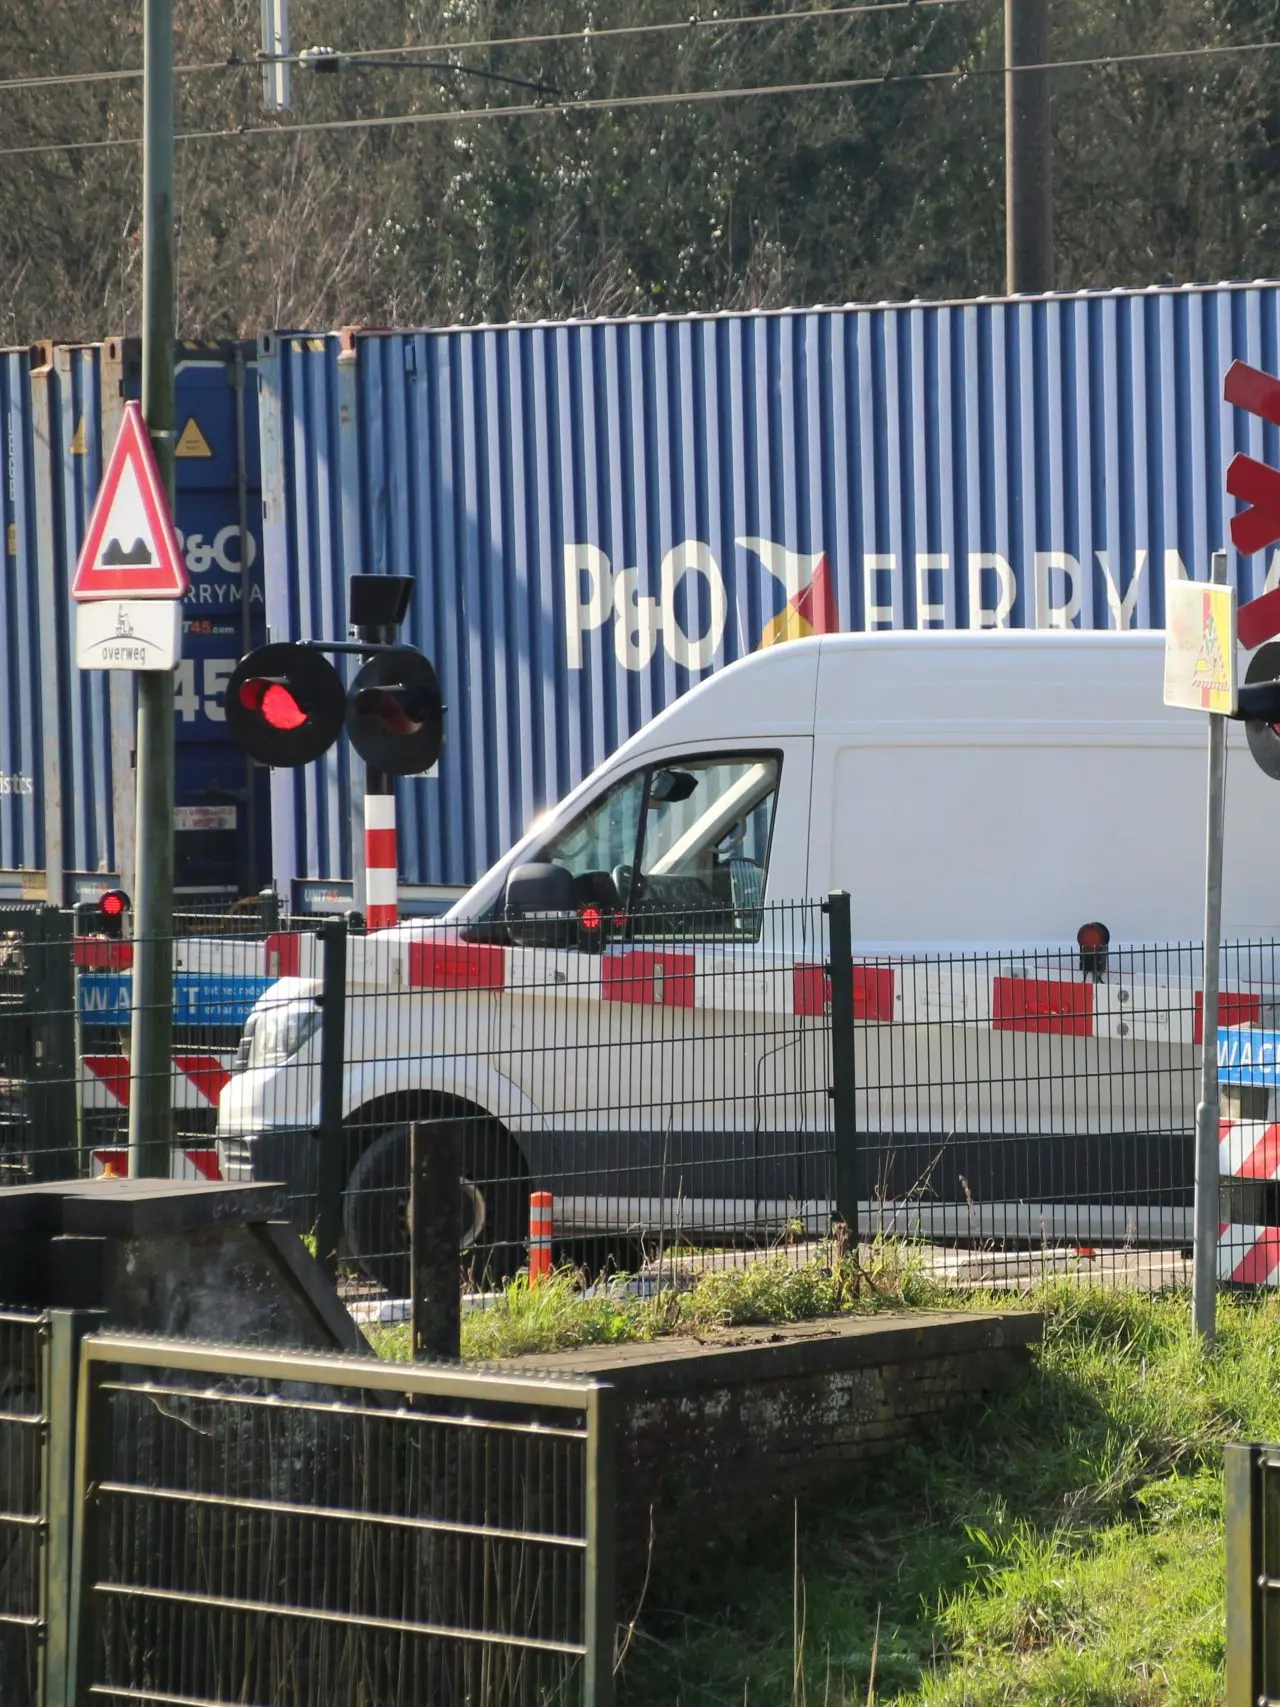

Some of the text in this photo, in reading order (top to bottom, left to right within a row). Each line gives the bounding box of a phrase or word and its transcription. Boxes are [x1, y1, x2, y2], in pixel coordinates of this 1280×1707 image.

[564, 539, 728, 672] P&O
[102, 646, 146, 666] overweg
[173, 658, 237, 722] 45
[81, 986, 200, 1014] WAT
